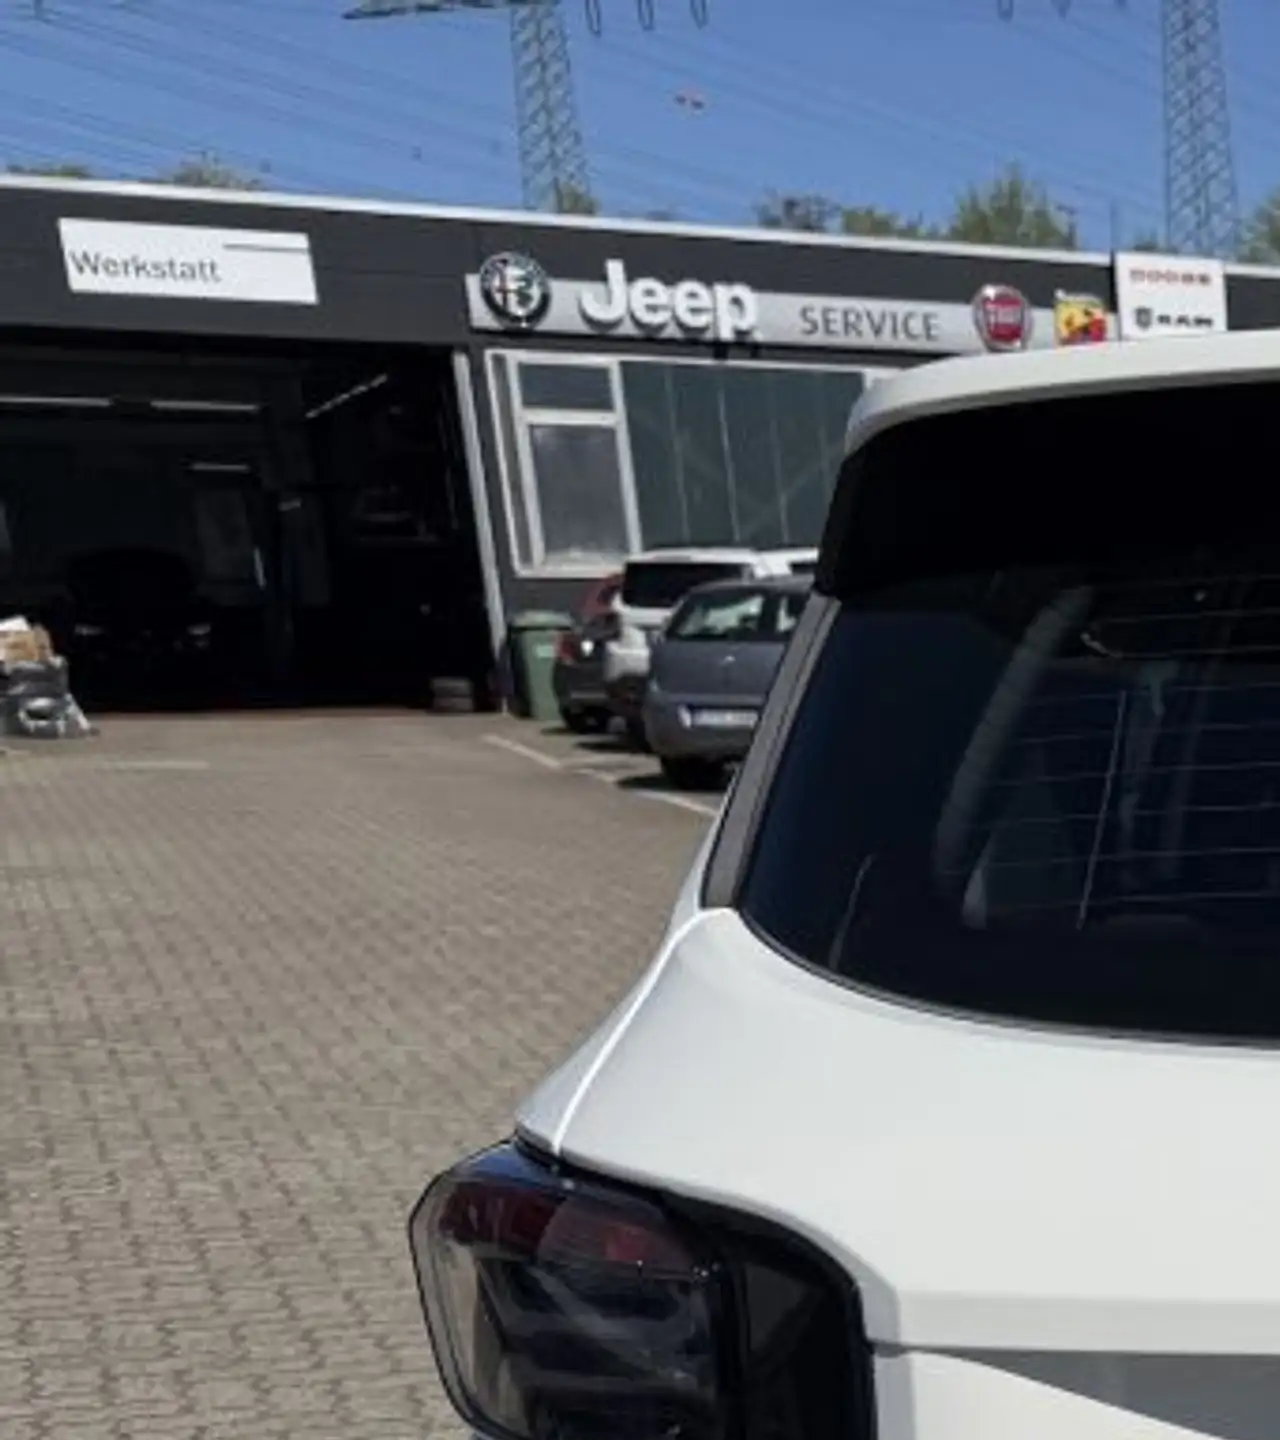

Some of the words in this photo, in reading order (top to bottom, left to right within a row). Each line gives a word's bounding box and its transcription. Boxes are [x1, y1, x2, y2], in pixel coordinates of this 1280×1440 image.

[69, 250, 222, 284] Werkstatt
[578, 259, 757, 342] Jeep
[799, 305, 941, 343] SERVICE
